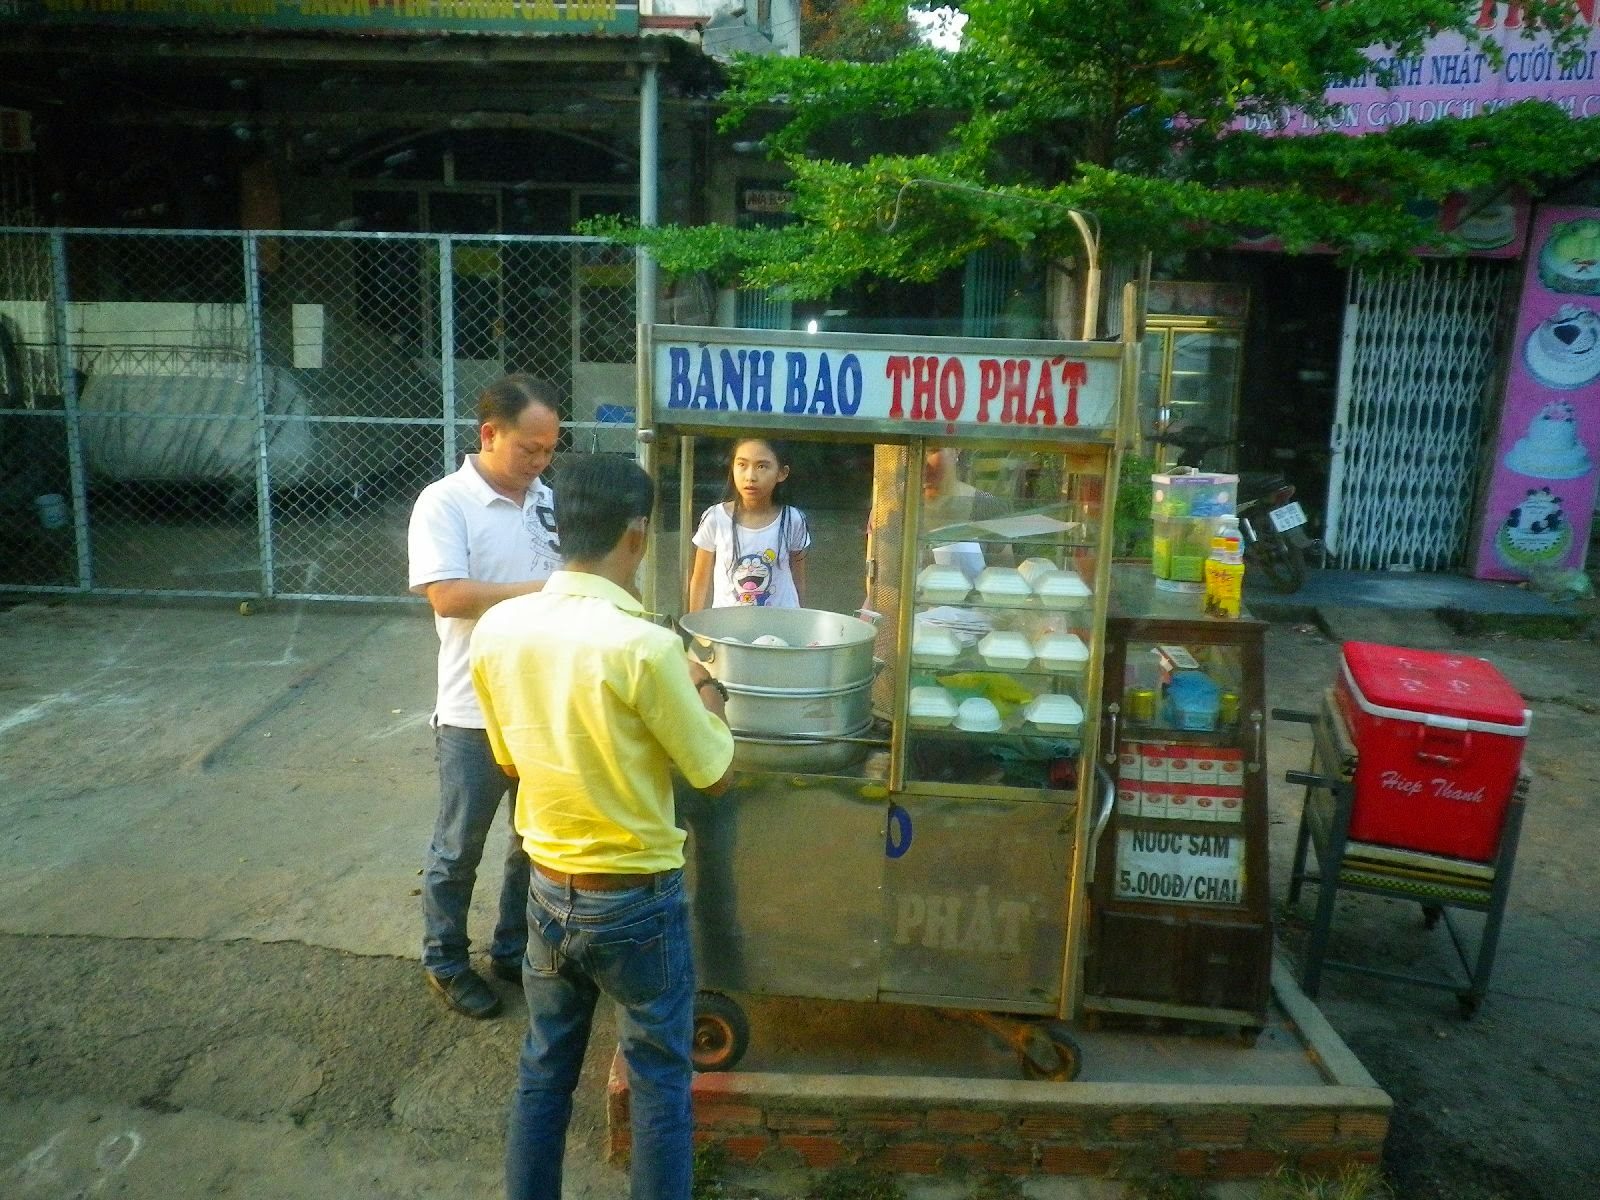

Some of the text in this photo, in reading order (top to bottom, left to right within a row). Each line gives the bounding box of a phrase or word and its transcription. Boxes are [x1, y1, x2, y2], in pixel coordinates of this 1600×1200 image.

[667, 341, 1087, 434] BÁNH BAO THỌ PHÁT
